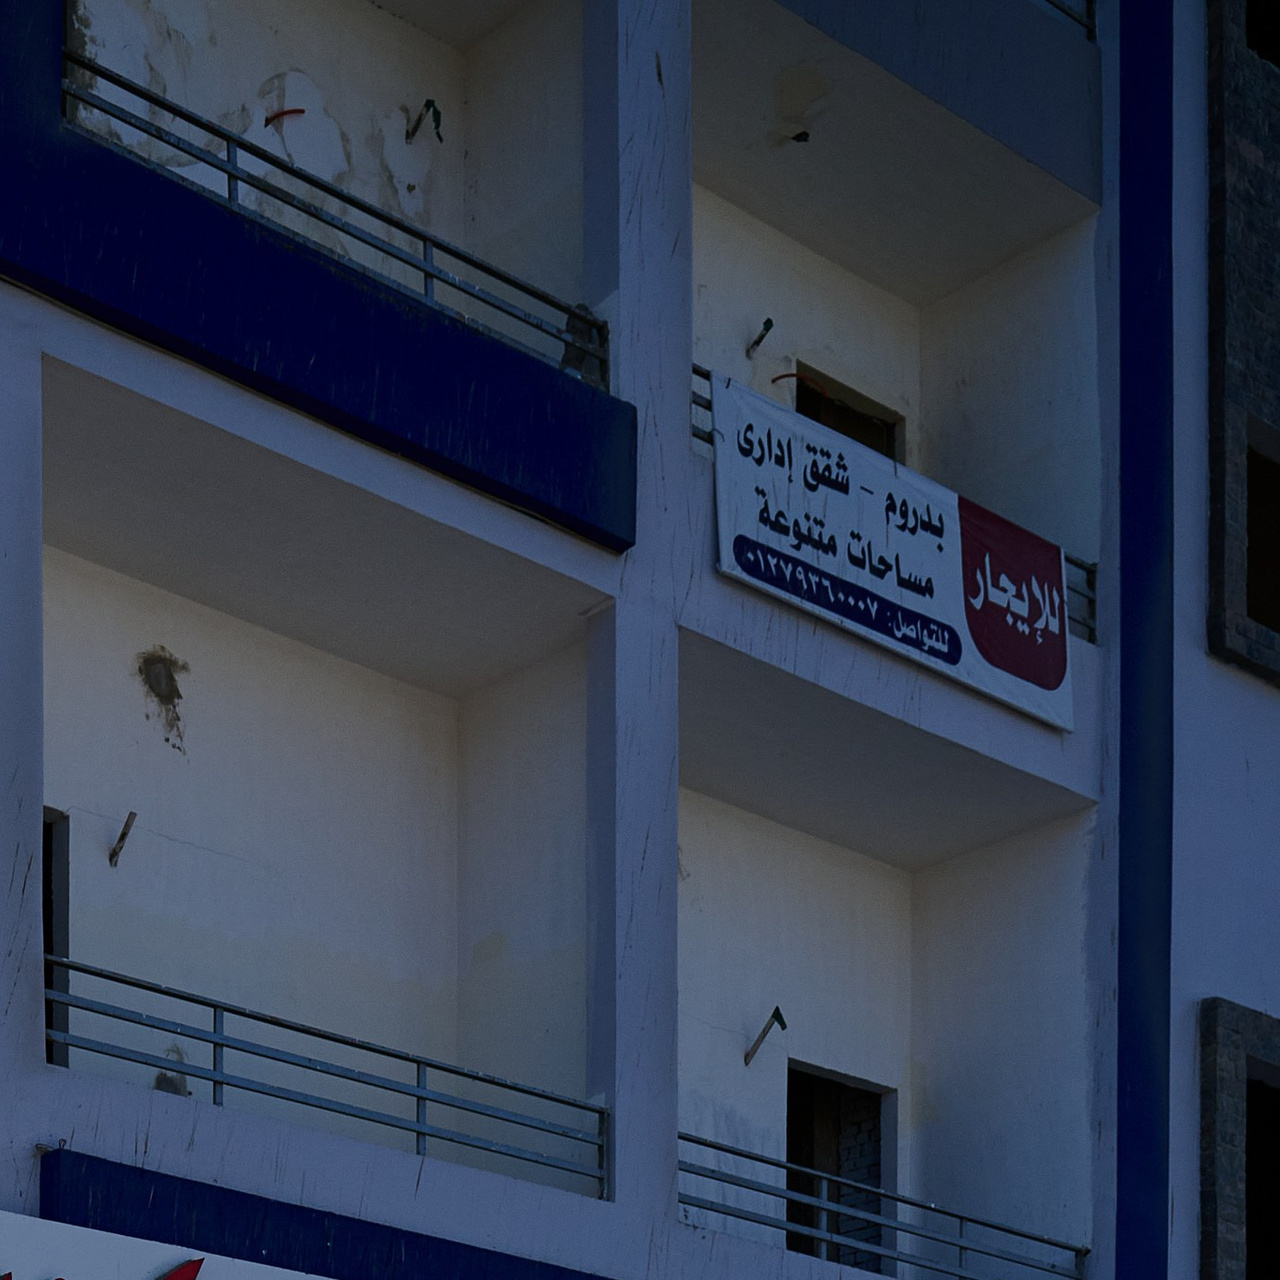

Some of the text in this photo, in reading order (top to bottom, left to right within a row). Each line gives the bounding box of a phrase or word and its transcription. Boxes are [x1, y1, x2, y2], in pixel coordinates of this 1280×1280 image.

[802, 441, 851, 496] شقق
[754, 486, 935, 599] مساحات متنوعة
[884, 493, 945, 553] بدروم
[968, 553, 1061, 645] للإيجار
